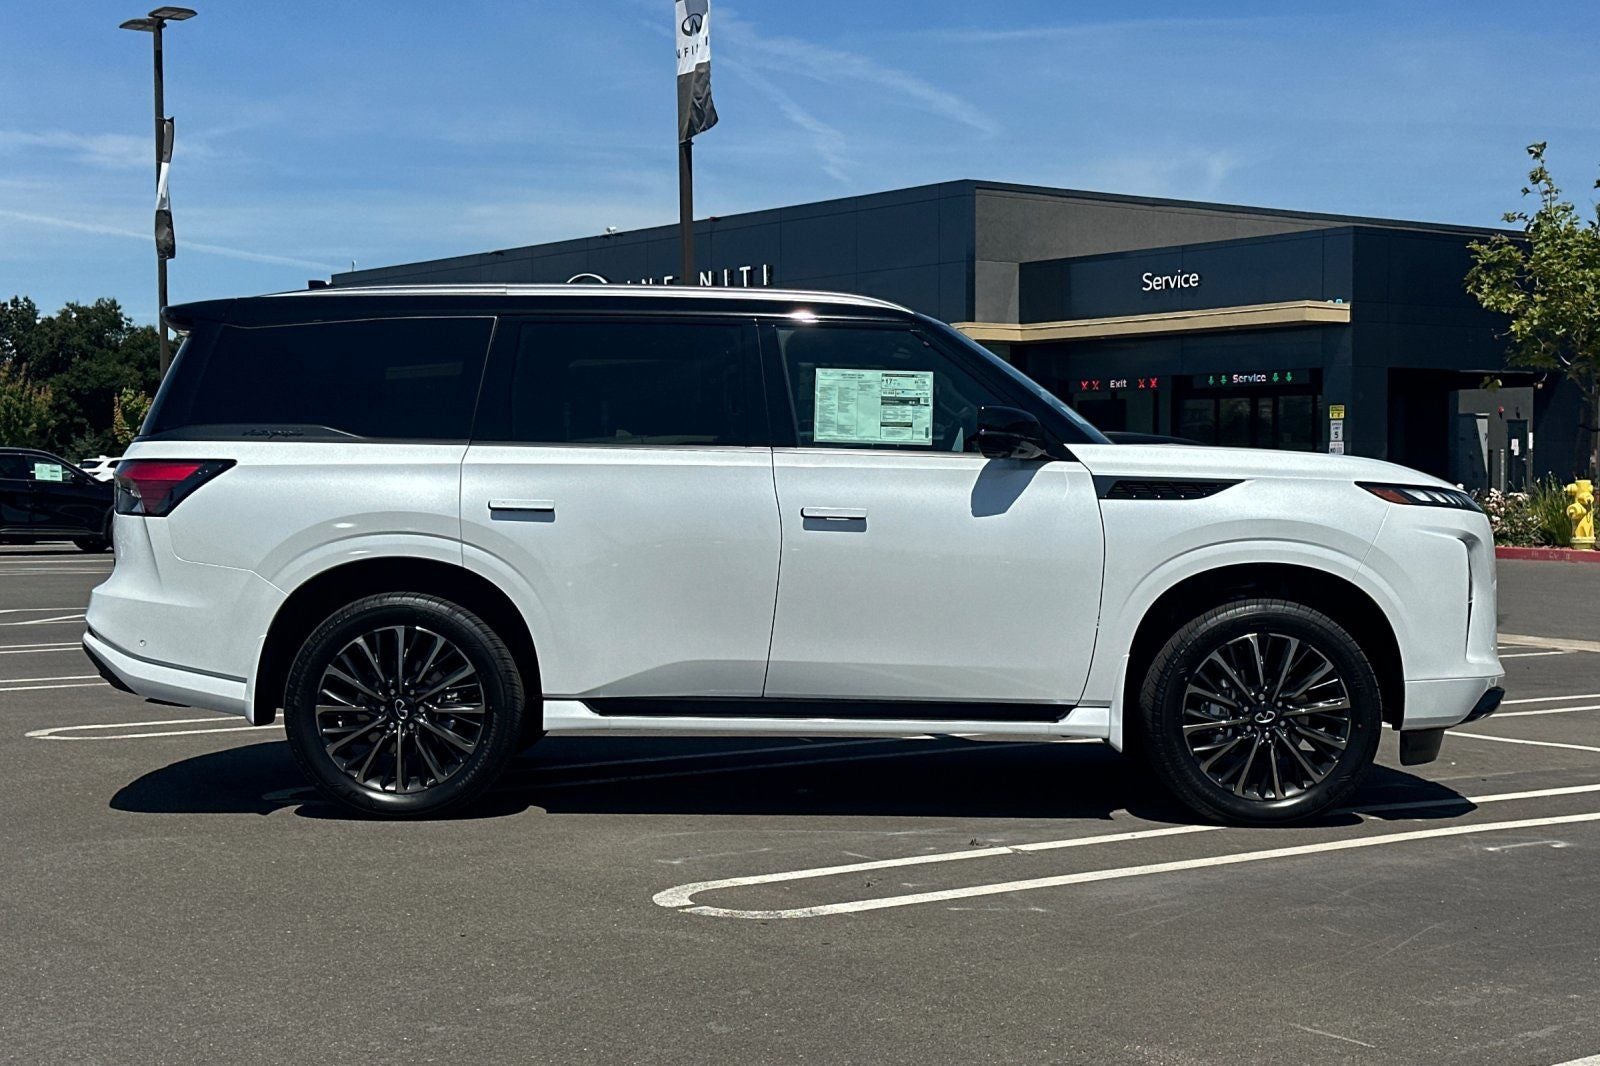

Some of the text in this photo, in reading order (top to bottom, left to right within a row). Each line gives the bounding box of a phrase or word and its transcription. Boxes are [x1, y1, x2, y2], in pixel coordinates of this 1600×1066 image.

[1142, 269, 1199, 291] Service
[1232, 372, 1267, 384] Service
[1109, 379, 1127, 389] Exit
[1334, 431, 1339, 439] 5
